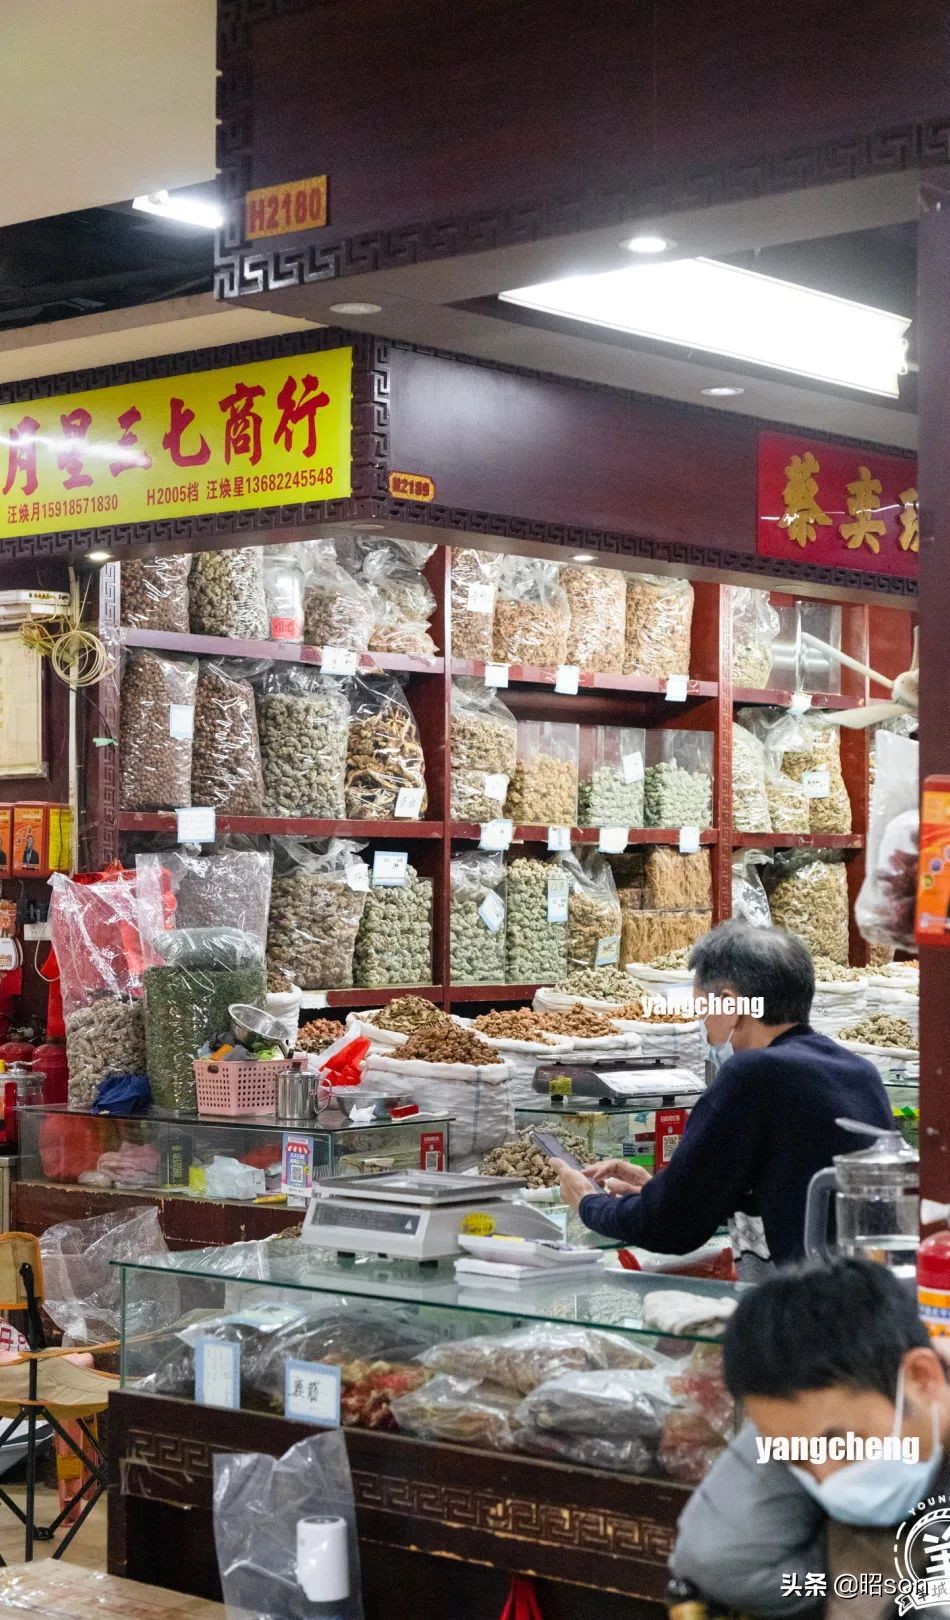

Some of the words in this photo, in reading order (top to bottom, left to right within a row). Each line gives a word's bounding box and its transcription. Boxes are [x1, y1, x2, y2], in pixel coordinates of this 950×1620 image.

[248, 187, 322, 233] H2180
[7, 494, 118, 524] 汪焕月15918571830
[147, 482, 199, 506] H2005档
[206, 467, 333, 500] 汪焕星13682245548
